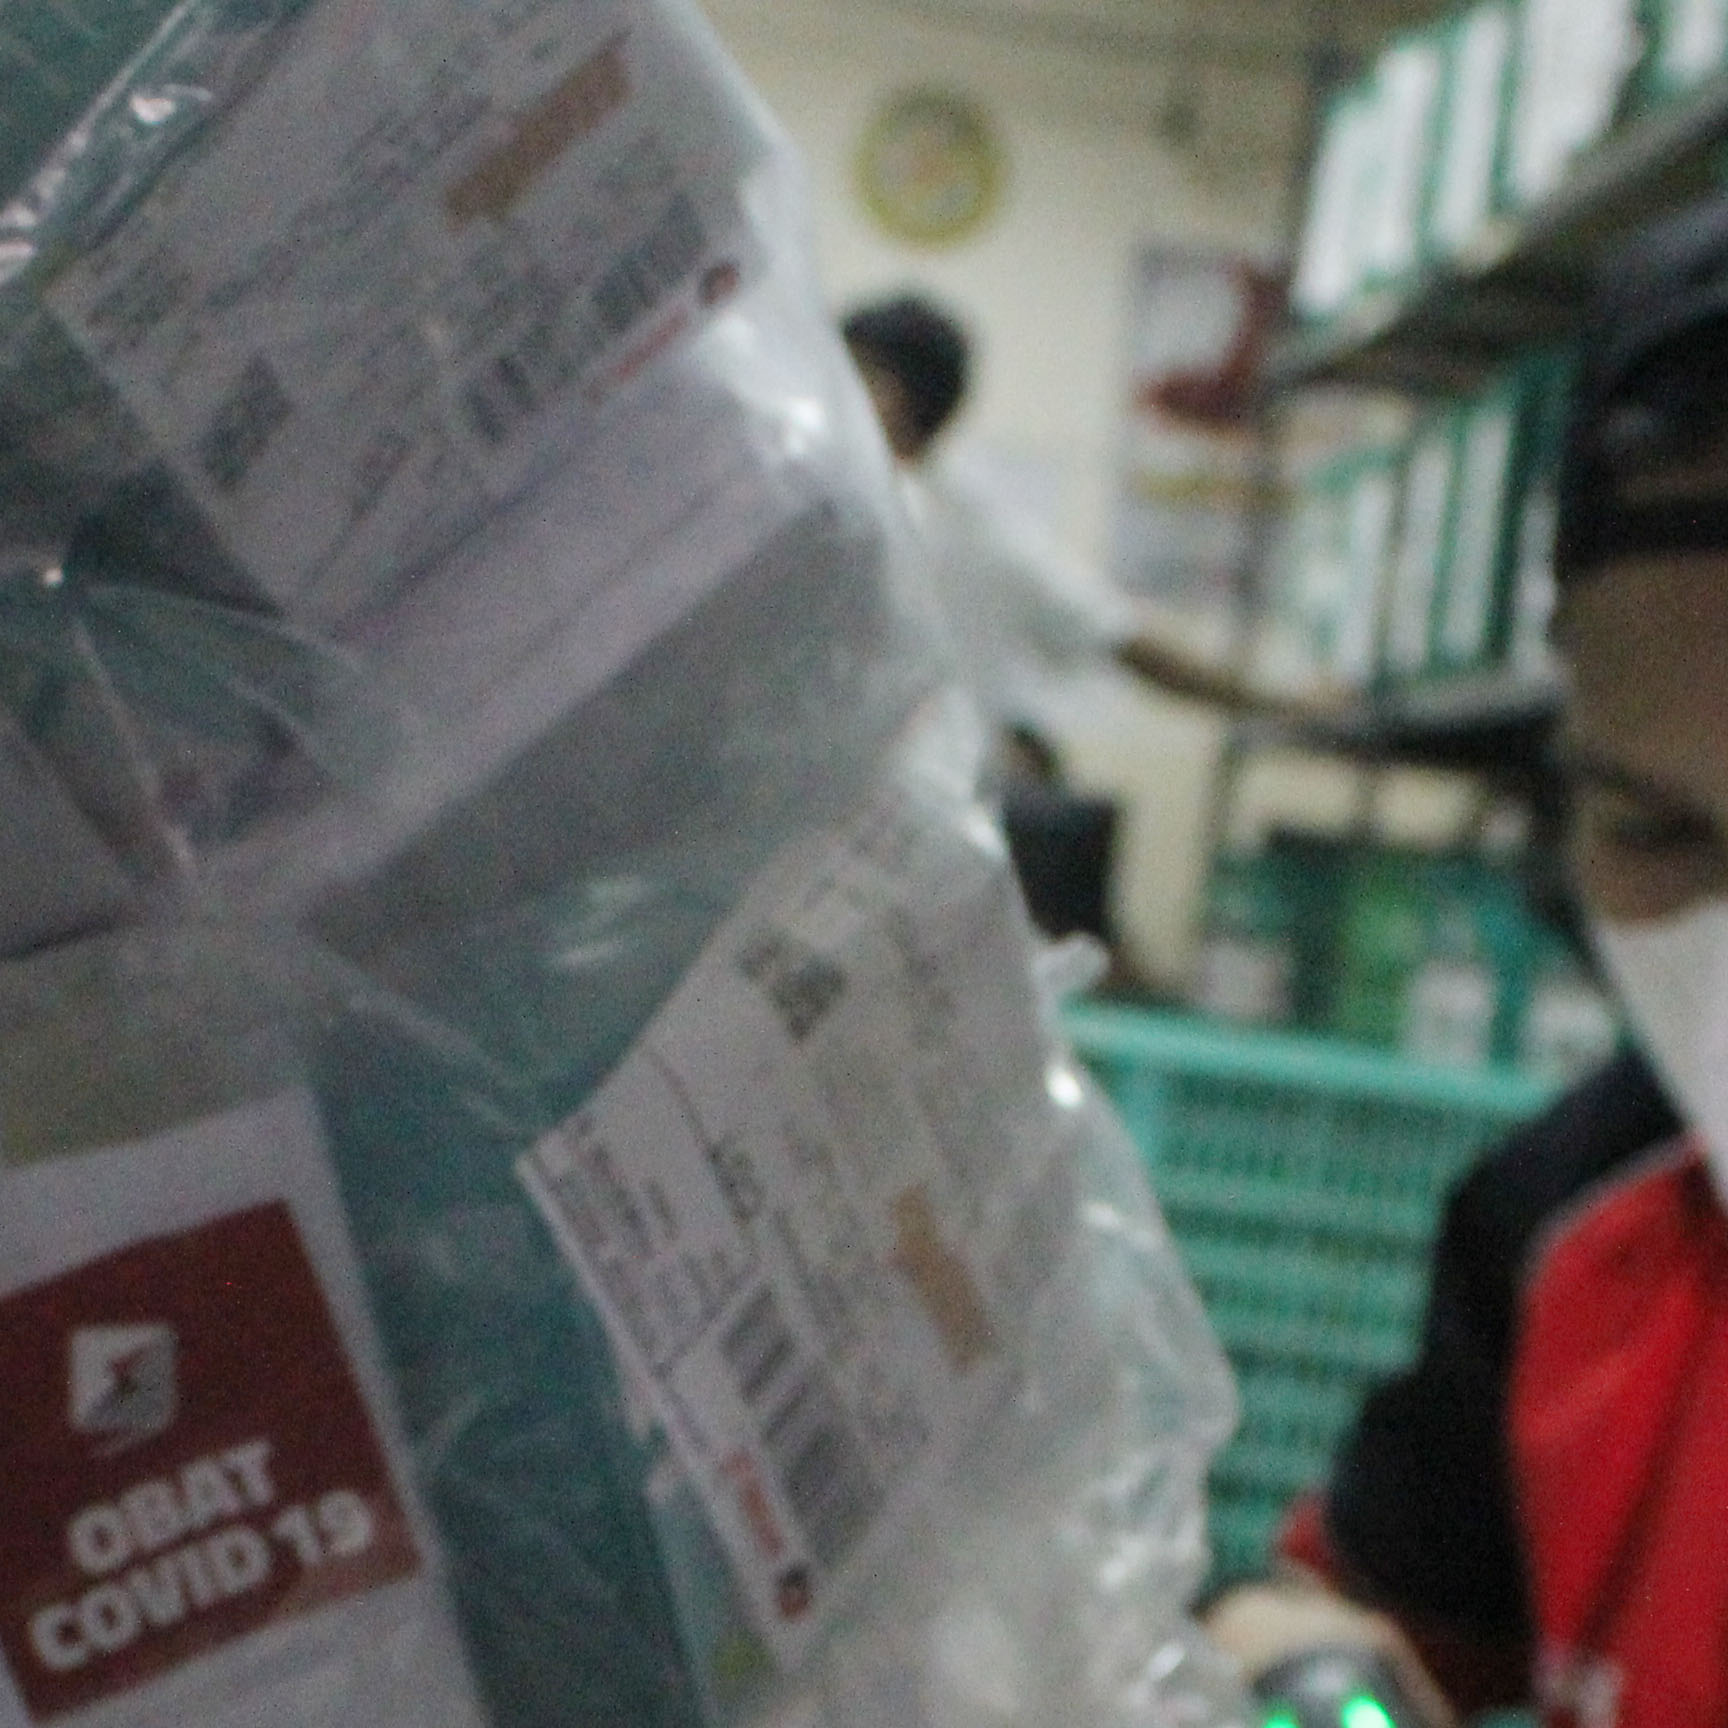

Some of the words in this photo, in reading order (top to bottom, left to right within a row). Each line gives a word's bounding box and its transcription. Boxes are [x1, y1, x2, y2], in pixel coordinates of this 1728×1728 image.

[29, 1526, 270, 1672] COVID
[272, 1489, 371, 1567] 19
[69, 1440, 273, 1576] OBAT
